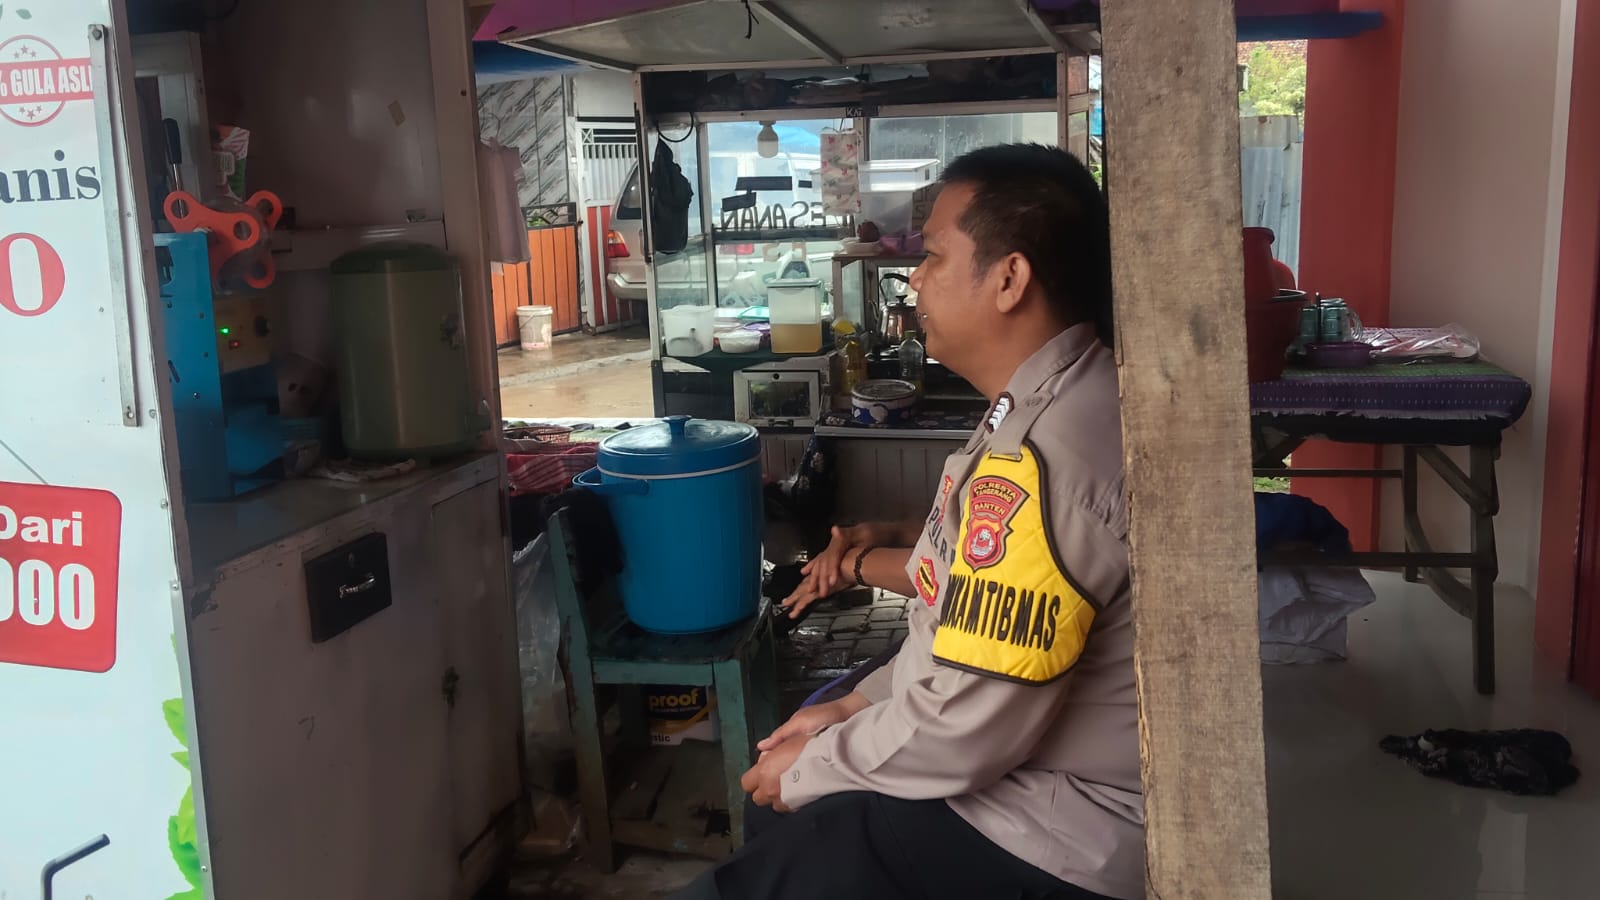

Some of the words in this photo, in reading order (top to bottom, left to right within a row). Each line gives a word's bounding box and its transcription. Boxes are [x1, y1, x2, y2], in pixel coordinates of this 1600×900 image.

[10, 67, 56, 97] GULA
[58, 65, 93, 94] ASLI
[973, 481, 1017, 499] POLRESTA
[974, 503, 1006, 515] BANTEN
